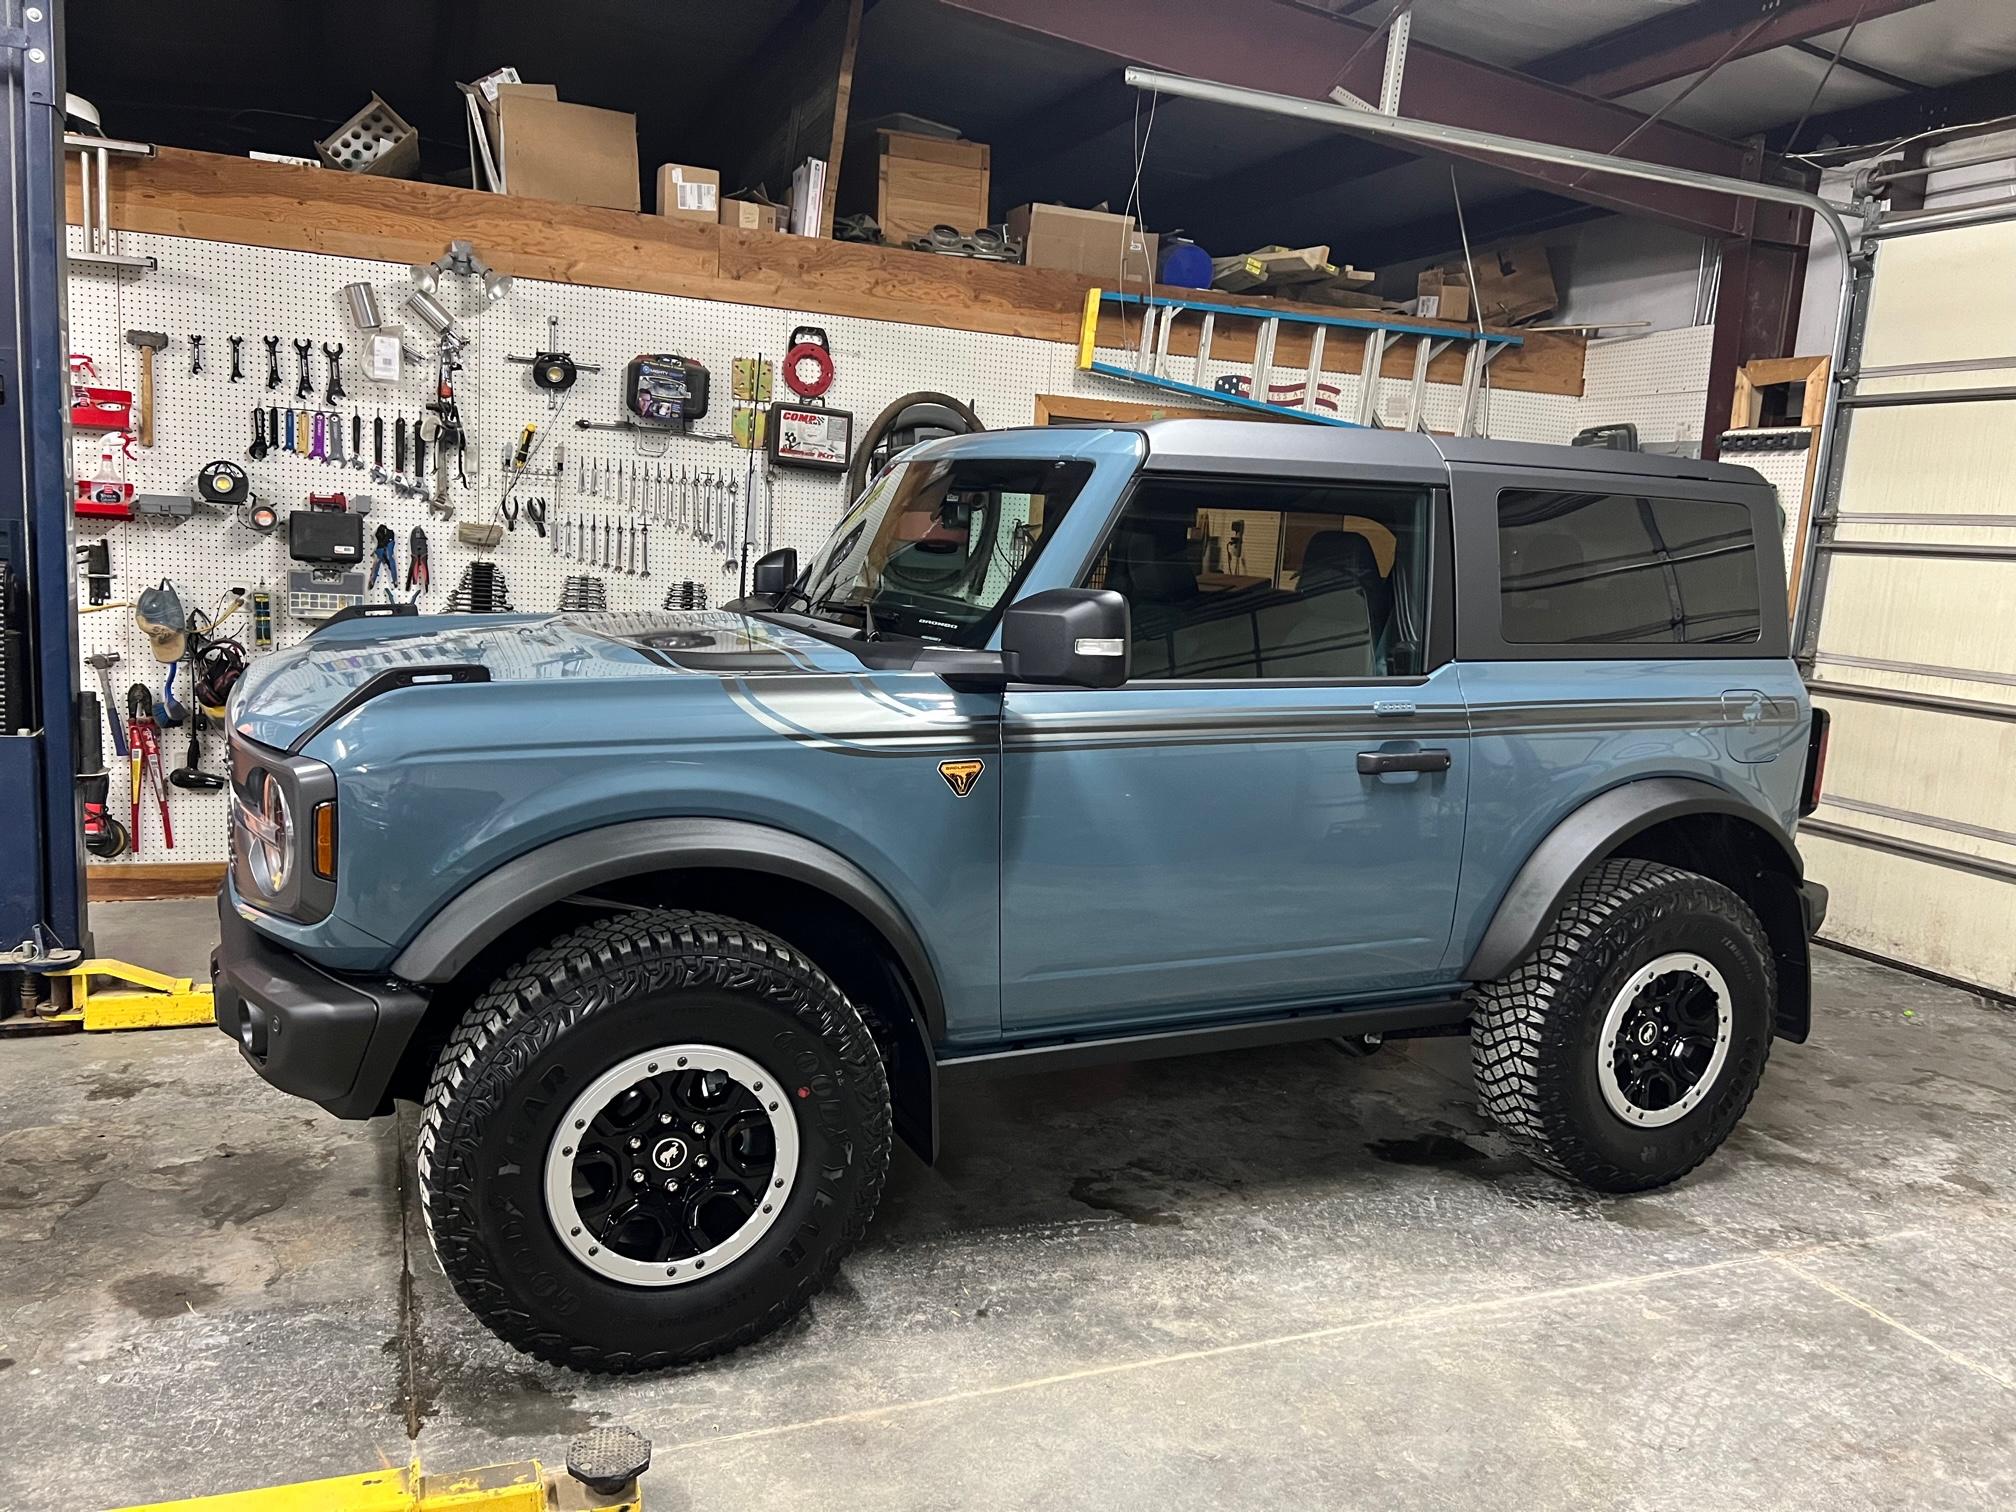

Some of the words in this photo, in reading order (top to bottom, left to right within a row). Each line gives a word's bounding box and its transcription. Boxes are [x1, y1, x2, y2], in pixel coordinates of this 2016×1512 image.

[1293, 390, 1332, 400] AMICA
[783, 412, 817, 422] COMP
[918, 618, 958, 629] BRONCO
